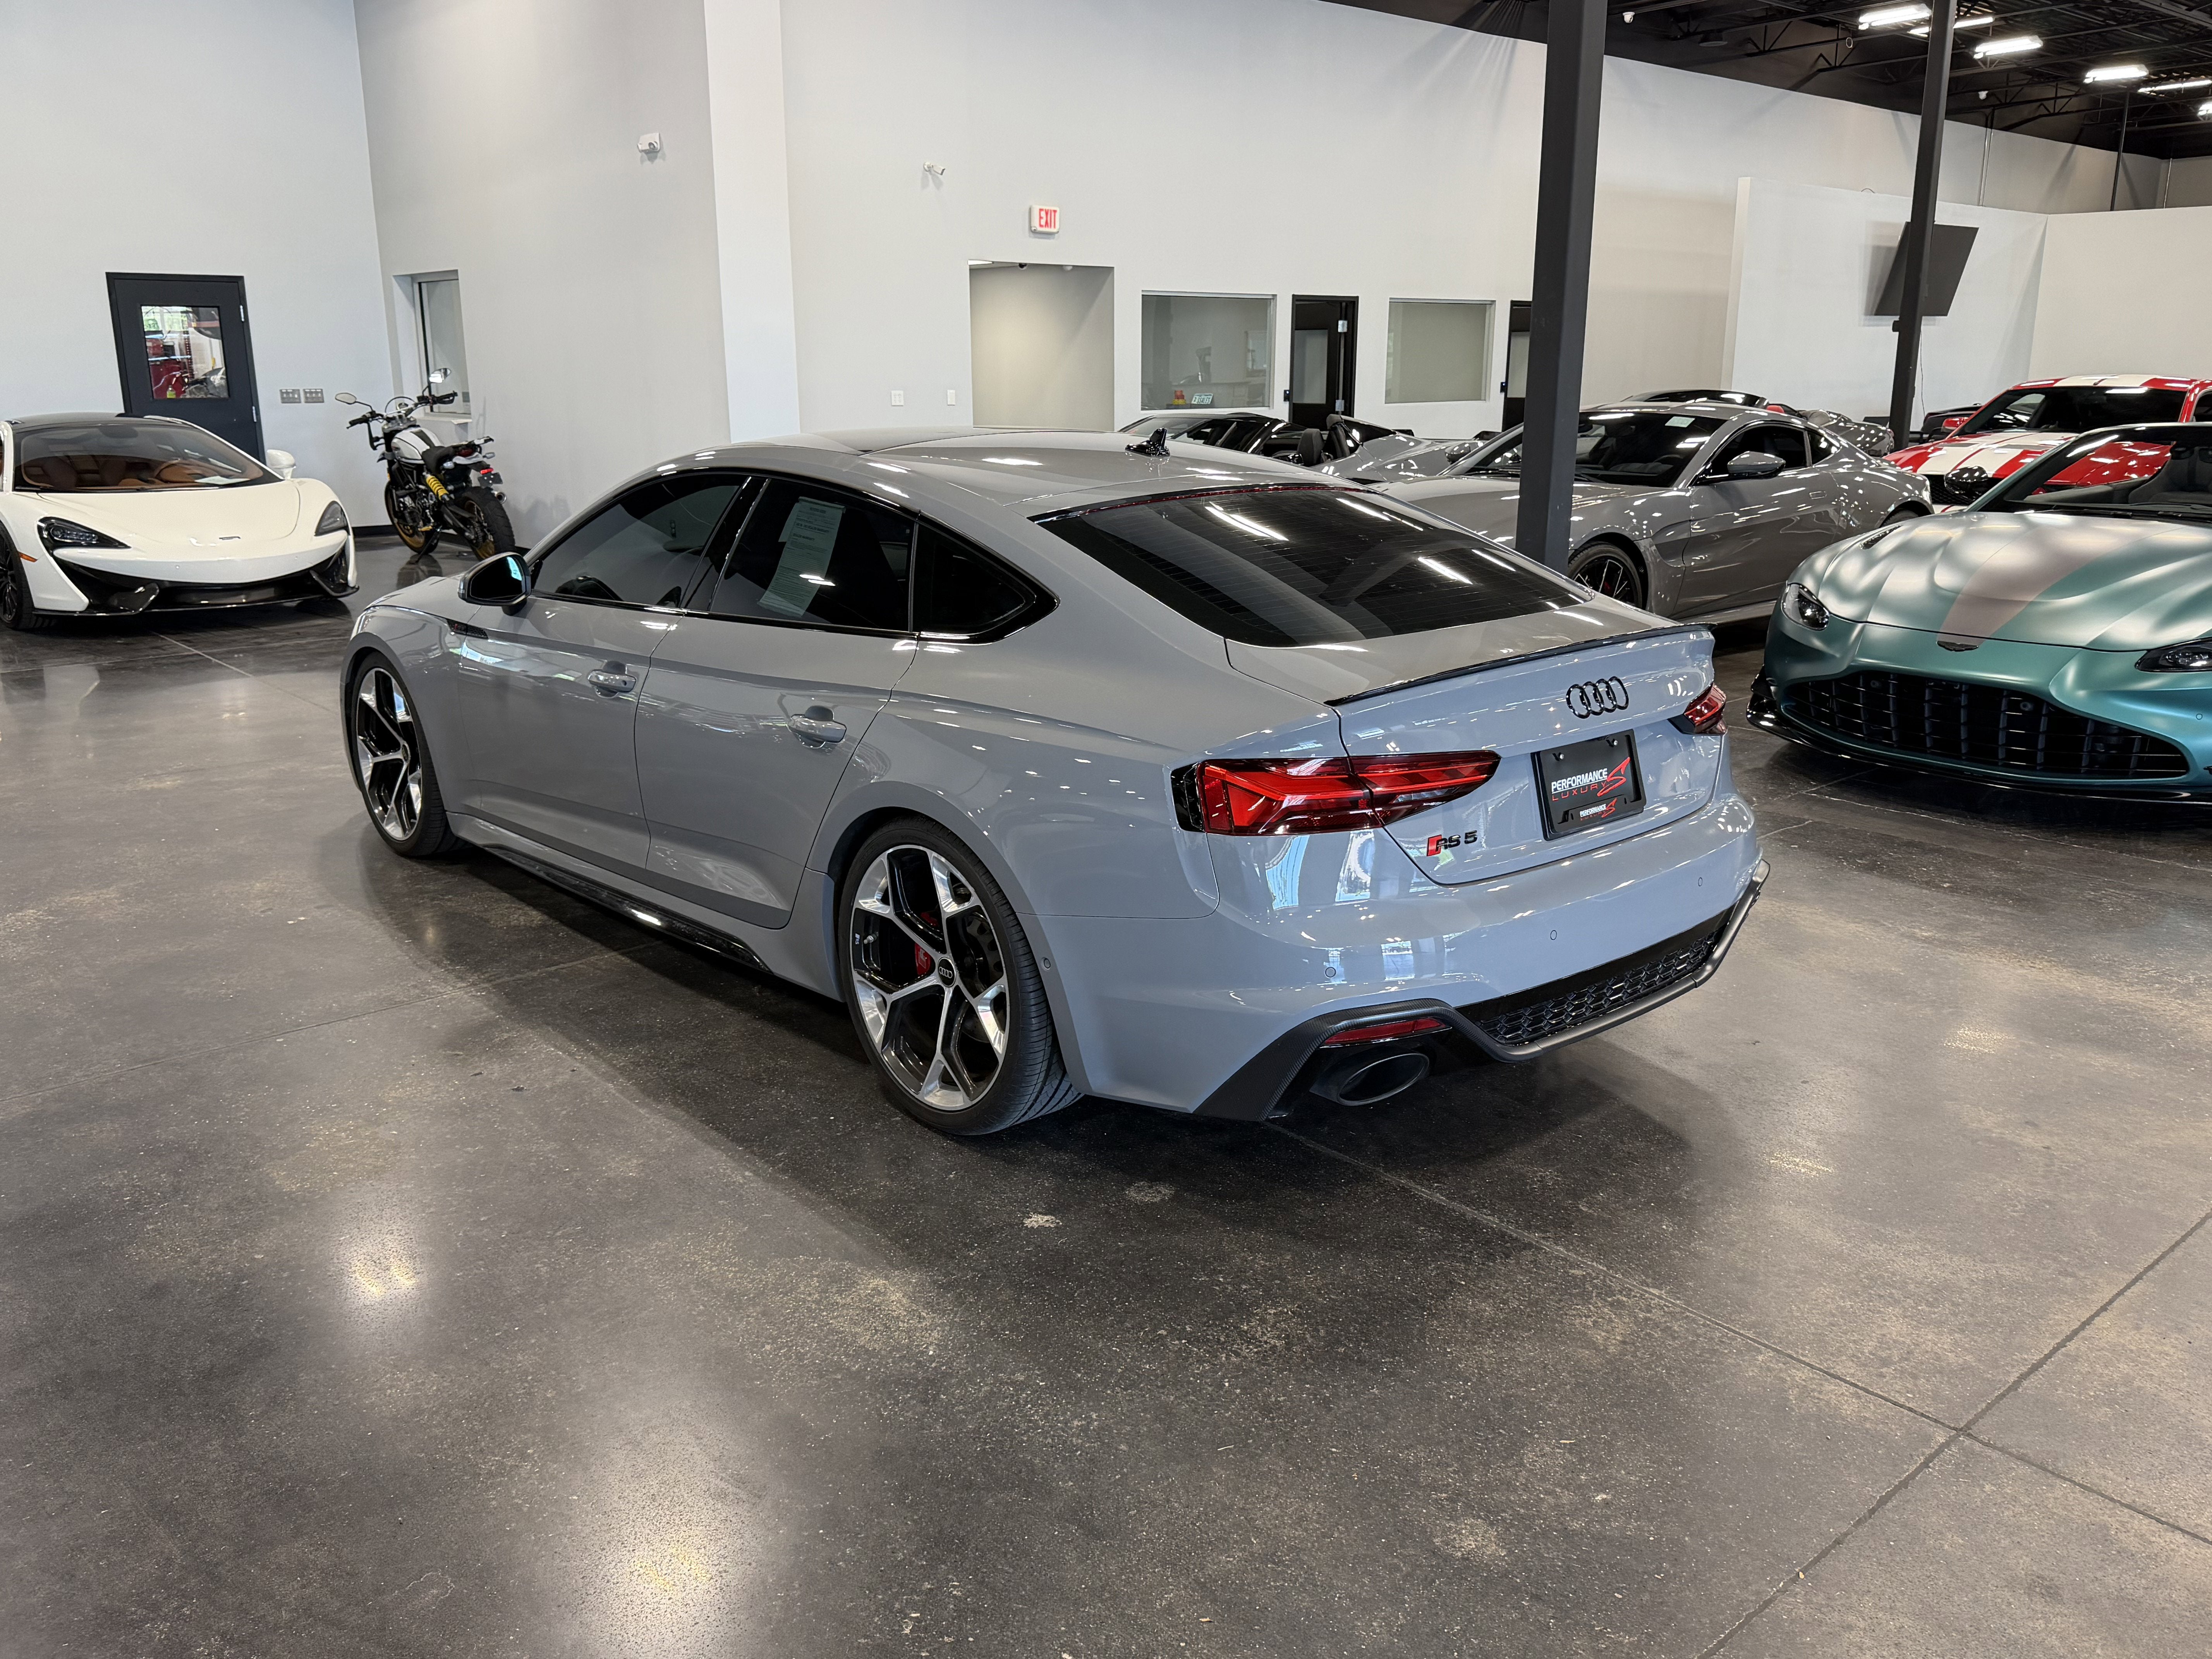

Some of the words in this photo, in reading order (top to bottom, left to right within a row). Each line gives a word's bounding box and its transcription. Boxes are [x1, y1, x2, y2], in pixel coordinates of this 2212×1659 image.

[1039, 208, 1057, 229] EXIT
[1552, 768, 1607, 792] PERFORMANCE
[1552, 781, 1607, 801] LUXURY
[1435, 834, 1461, 852] RS
[1464, 830, 1478, 844] 5
